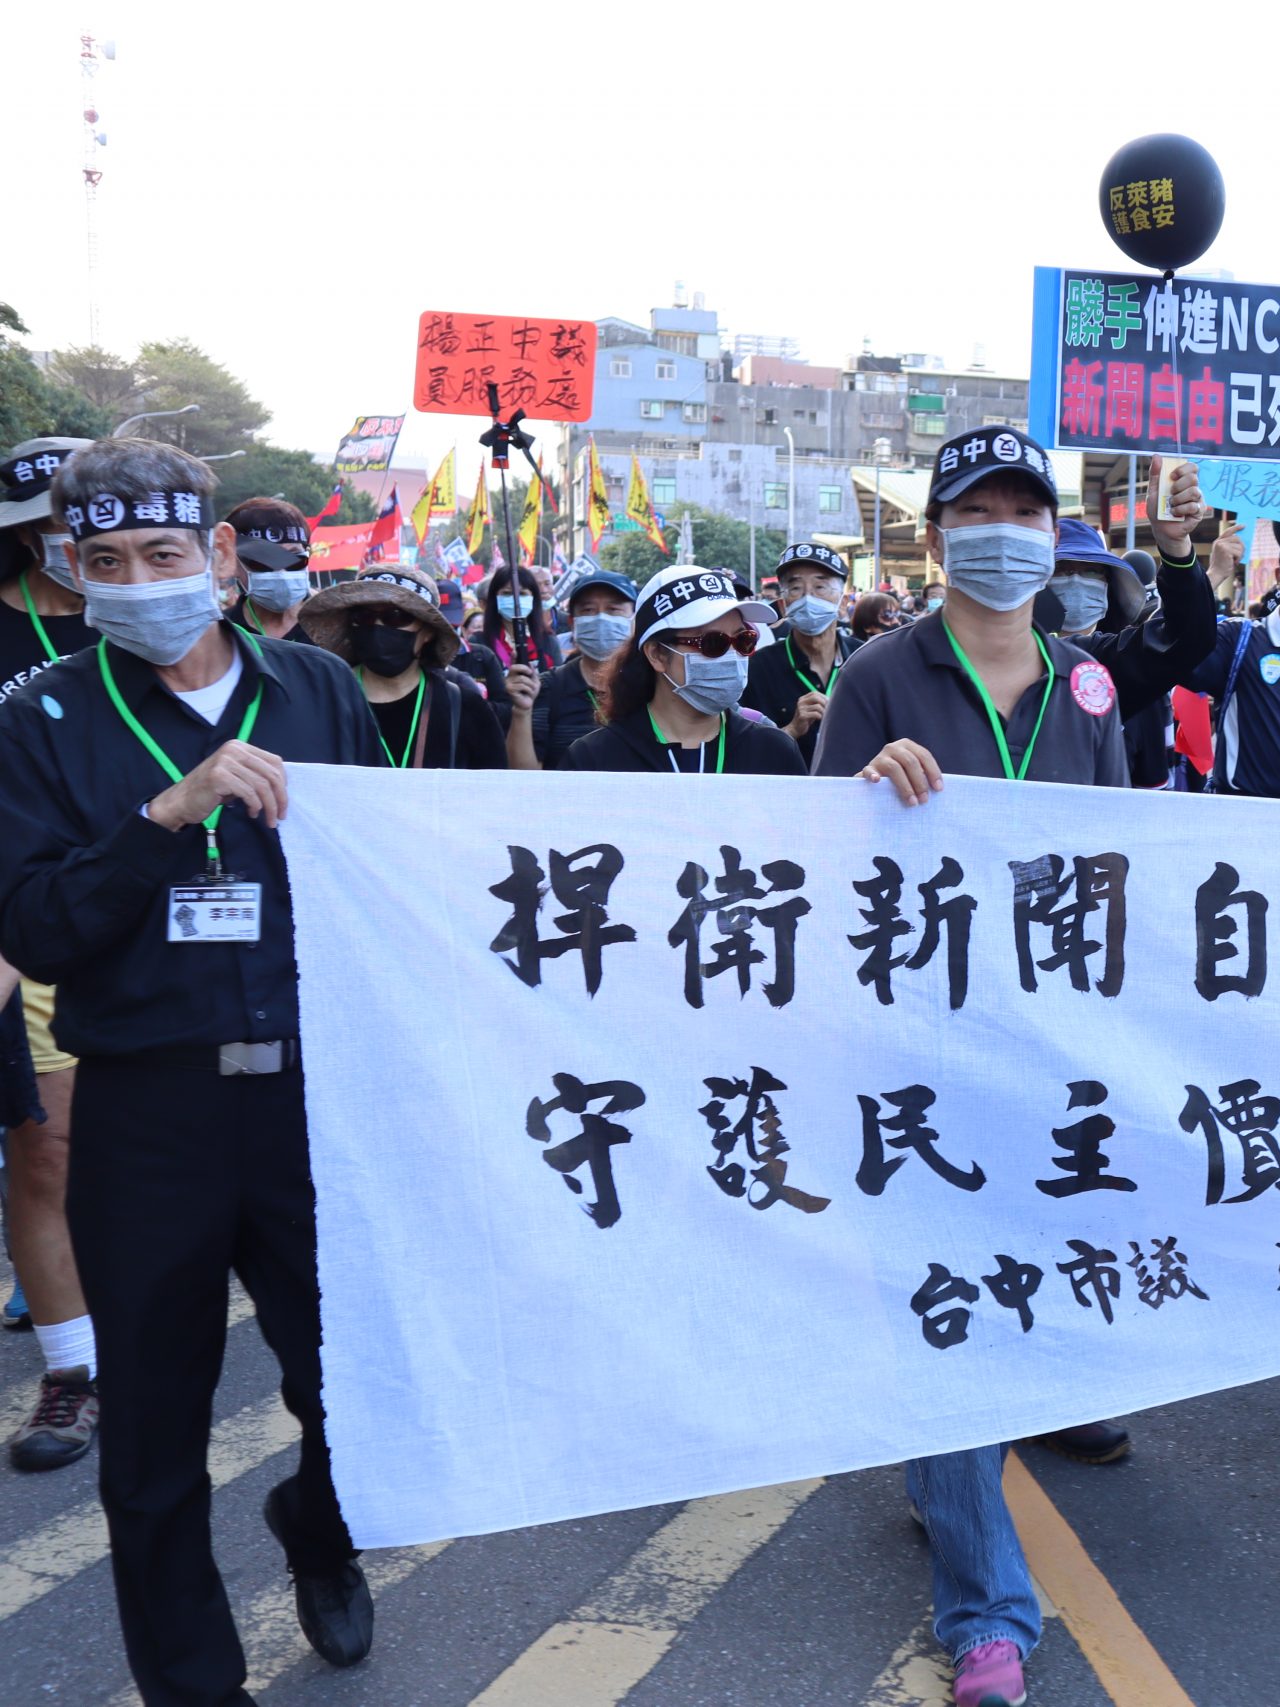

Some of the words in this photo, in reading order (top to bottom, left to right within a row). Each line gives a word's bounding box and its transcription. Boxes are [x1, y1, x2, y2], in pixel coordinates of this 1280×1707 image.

[1110, 178, 1173, 212] 反萊豬
[1112, 203, 1175, 235] 護食安
